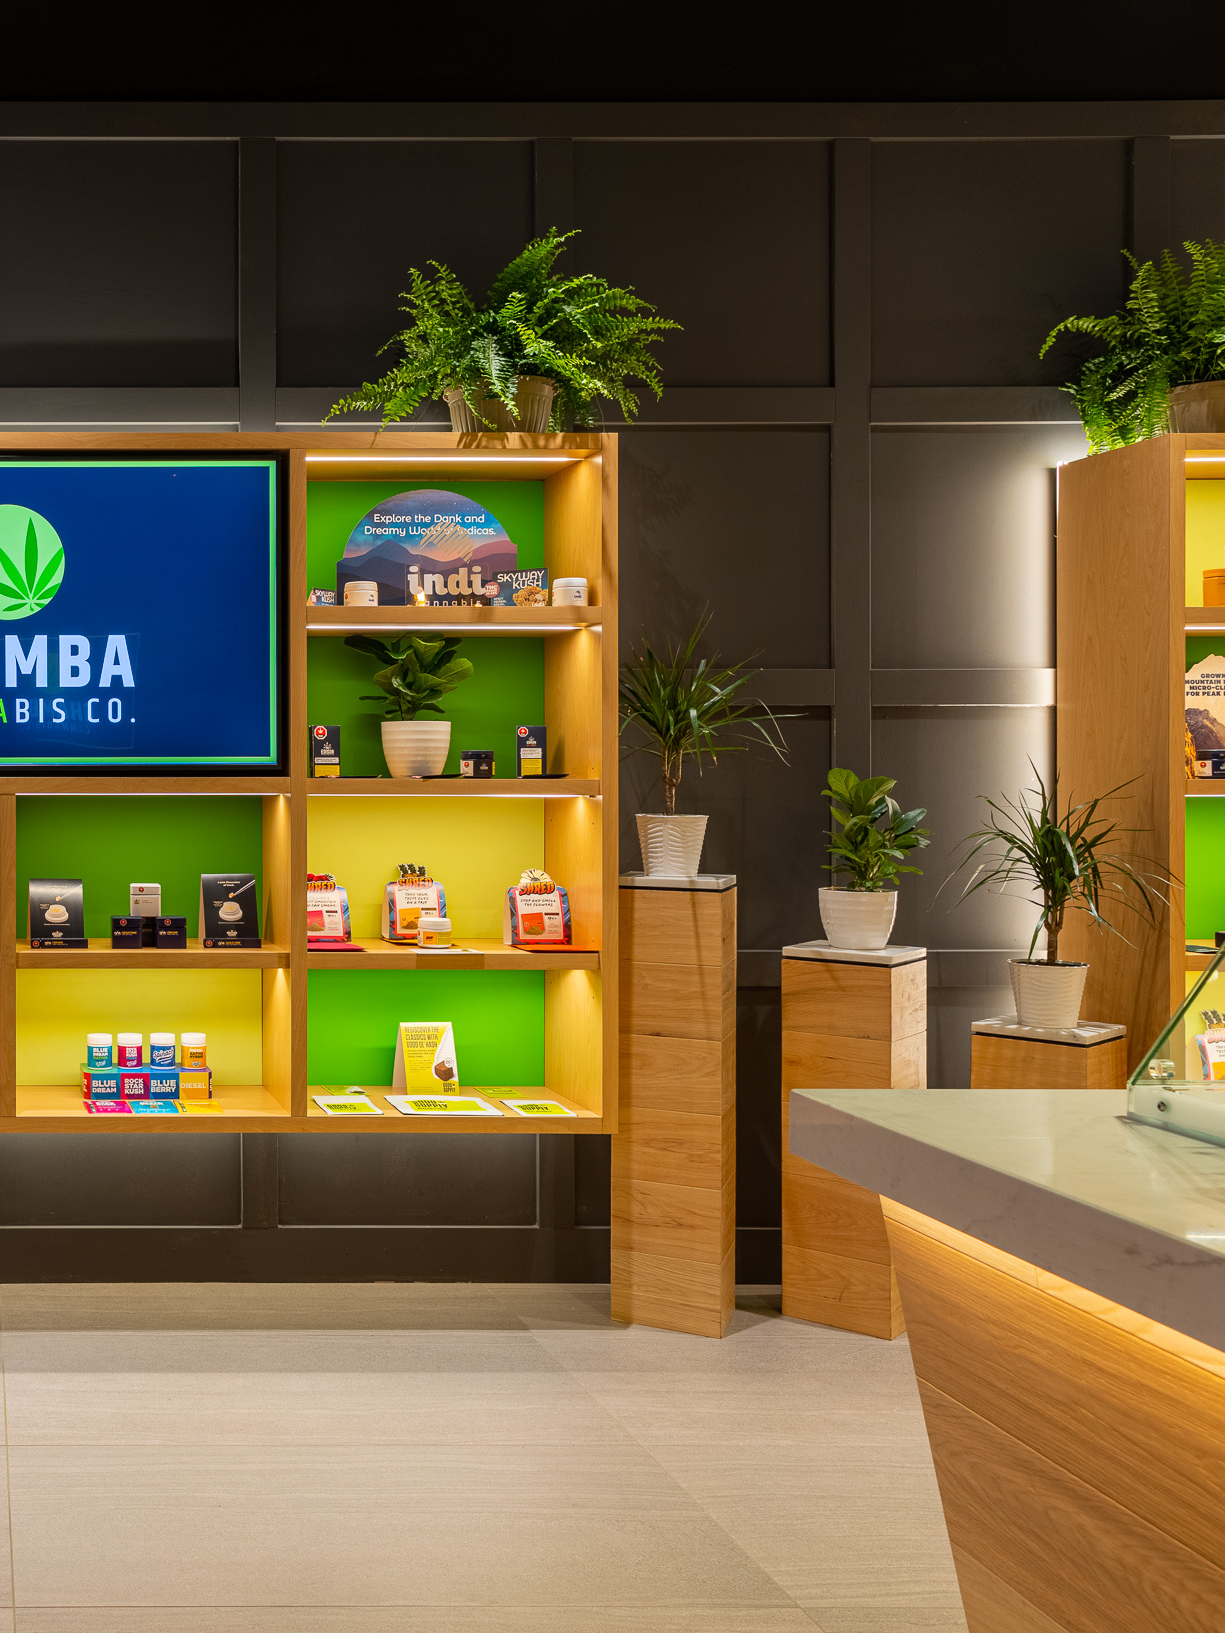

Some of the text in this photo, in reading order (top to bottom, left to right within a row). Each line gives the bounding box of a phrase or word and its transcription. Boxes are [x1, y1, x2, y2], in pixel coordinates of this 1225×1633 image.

[374, 514, 485, 524] Explore the Dank and
[365, 526, 406, 536] Dreamy
[407, 566, 485, 595] indi
[497, 570, 545, 583] SKYWAY
[513, 580, 542, 590] KUSH
[416, 599, 482, 607] annabis
[87, 698, 136, 723] CO.
[307, 882, 337, 892] HRED
[398, 878, 434, 891] SHRED
[519, 882, 555, 896] SHRED
